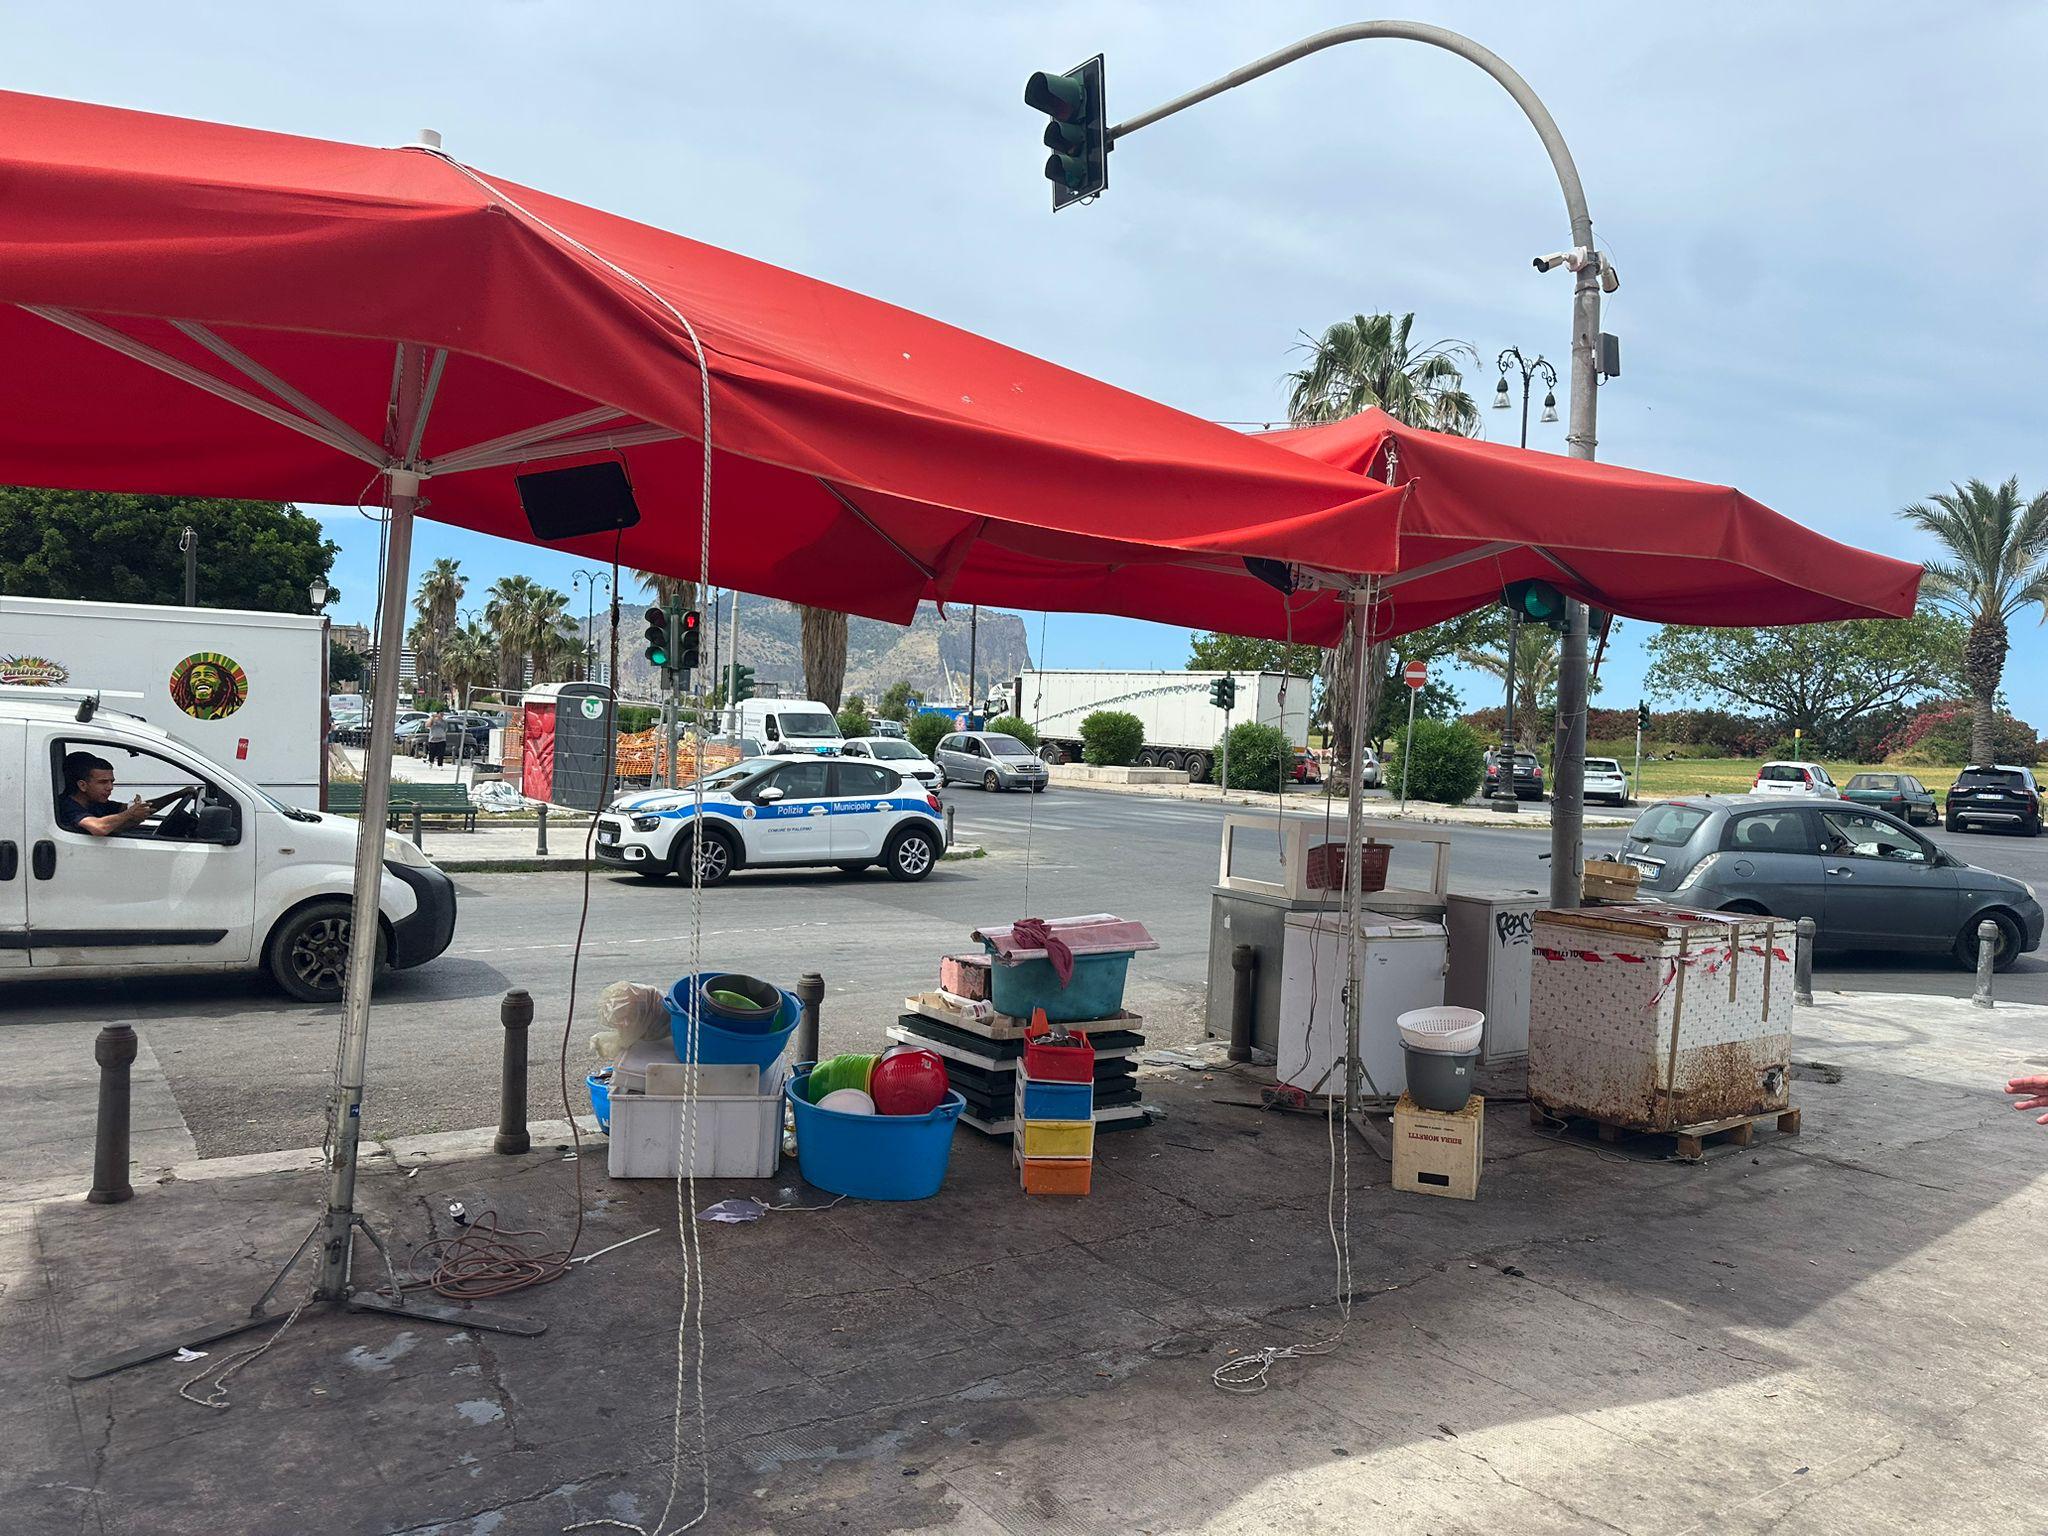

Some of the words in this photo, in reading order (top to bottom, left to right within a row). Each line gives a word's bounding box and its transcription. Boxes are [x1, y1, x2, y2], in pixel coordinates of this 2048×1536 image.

[778, 805, 803, 815] Polizia
[834, 801, 871, 812] Municipale
[1408, 1132, 1440, 1142] MORETTI
[1441, 1136, 1462, 1145] BIRRA
